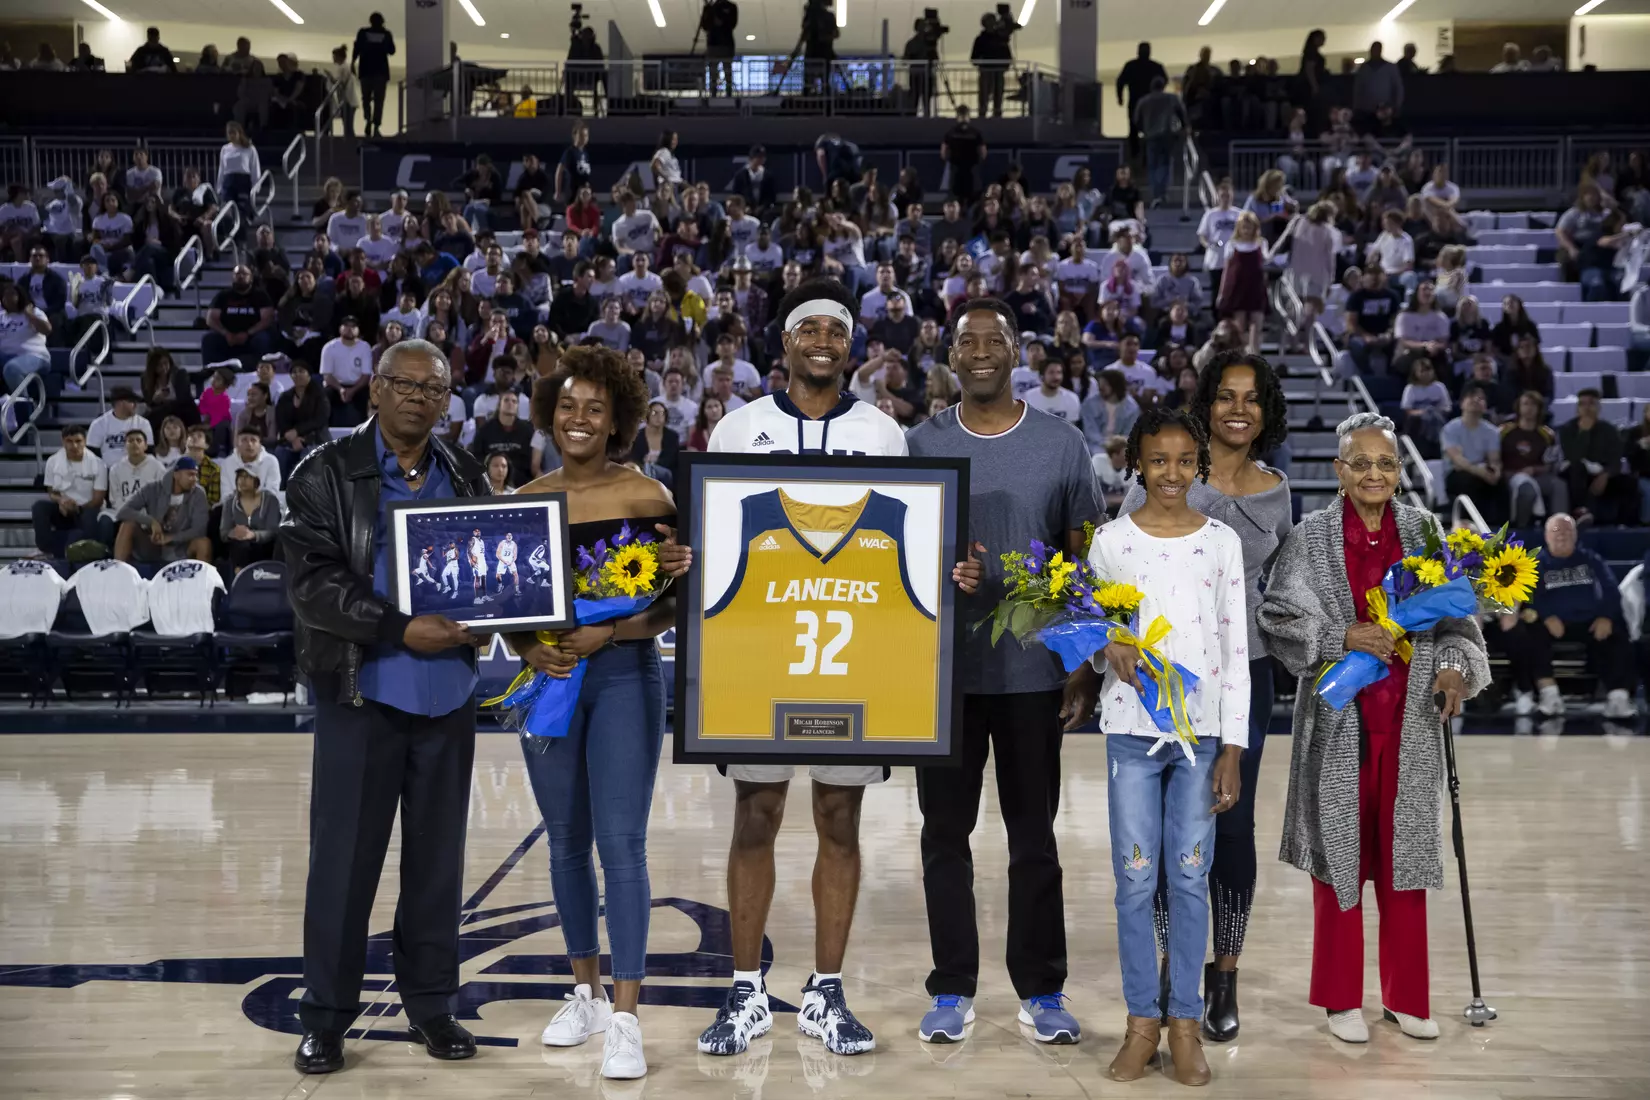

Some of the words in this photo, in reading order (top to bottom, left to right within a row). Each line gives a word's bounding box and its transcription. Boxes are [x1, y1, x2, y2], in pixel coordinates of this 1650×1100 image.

[752, 437, 775, 447] adidas
[758, 543, 781, 551] adidas
[858, 537, 890, 550] WAC
[765, 577, 880, 604] LANCERS
[788, 610, 854, 675] 32
